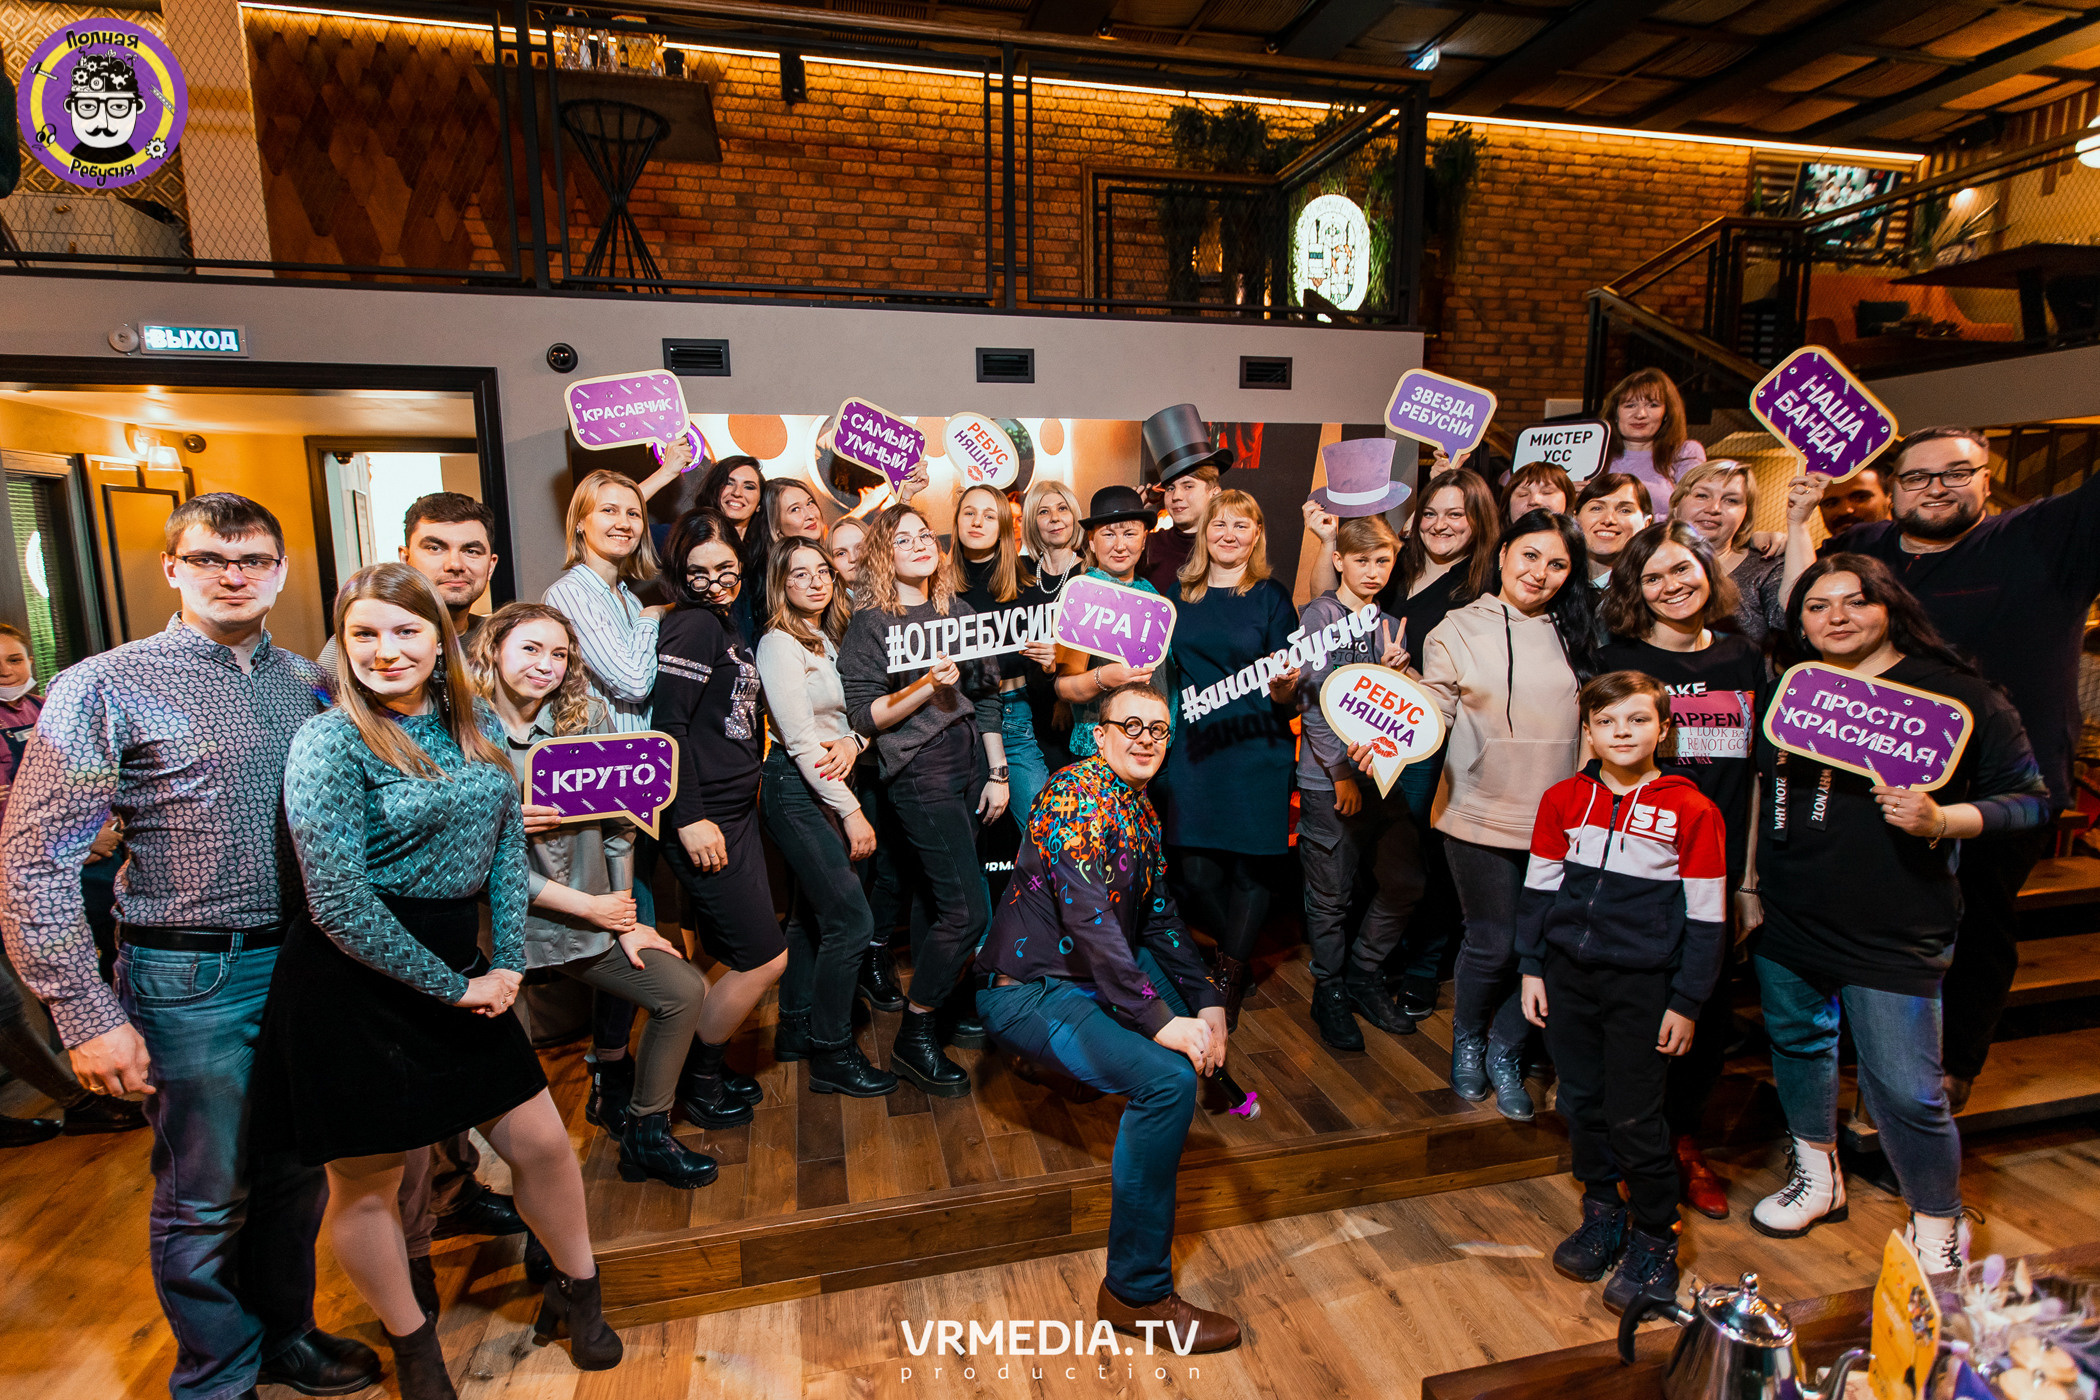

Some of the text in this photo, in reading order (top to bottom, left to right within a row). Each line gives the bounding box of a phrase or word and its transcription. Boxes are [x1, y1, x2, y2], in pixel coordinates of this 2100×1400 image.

[147, 328, 239, 351] ВЫХОД
[582, 398, 673, 422] КРАСАВЧИК
[1398, 401, 1474, 438] РЕБУСНИ
[1411, 386, 1475, 420] ЗВЕЗДА
[1798, 375, 1865, 442] НАША
[851, 413, 916, 454] САМЫЙ
[967, 422, 1009, 466] РЕБУС
[1530, 430, 1593, 447] МИСТЕР
[1774, 389, 1847, 462] БАНДА
[844, 431, 908, 471] УМНЫЙ
[954, 430, 999, 479] НЯШКА
[1542, 449, 1572, 463] УСС
[1181, 603, 1380, 723] #янаребусне
[1353, 675, 1425, 726] РЕБУС
[1664, 681, 1708, 698] AKE
[1338, 692, 1415, 748] НЯШКА
[1671, 712, 1741, 727] APPEN
[1811, 690, 1926, 736] ПРОСТО
[1699, 738, 1725, 751] NOT
[1727, 738, 1745, 750] GO
[1732, 729, 1745, 738] BA
[1783, 707, 1938, 768] КРАСИВАЯ
[552, 763, 656, 794] КРУТО
[1774, 804, 1787, 830] WHY
